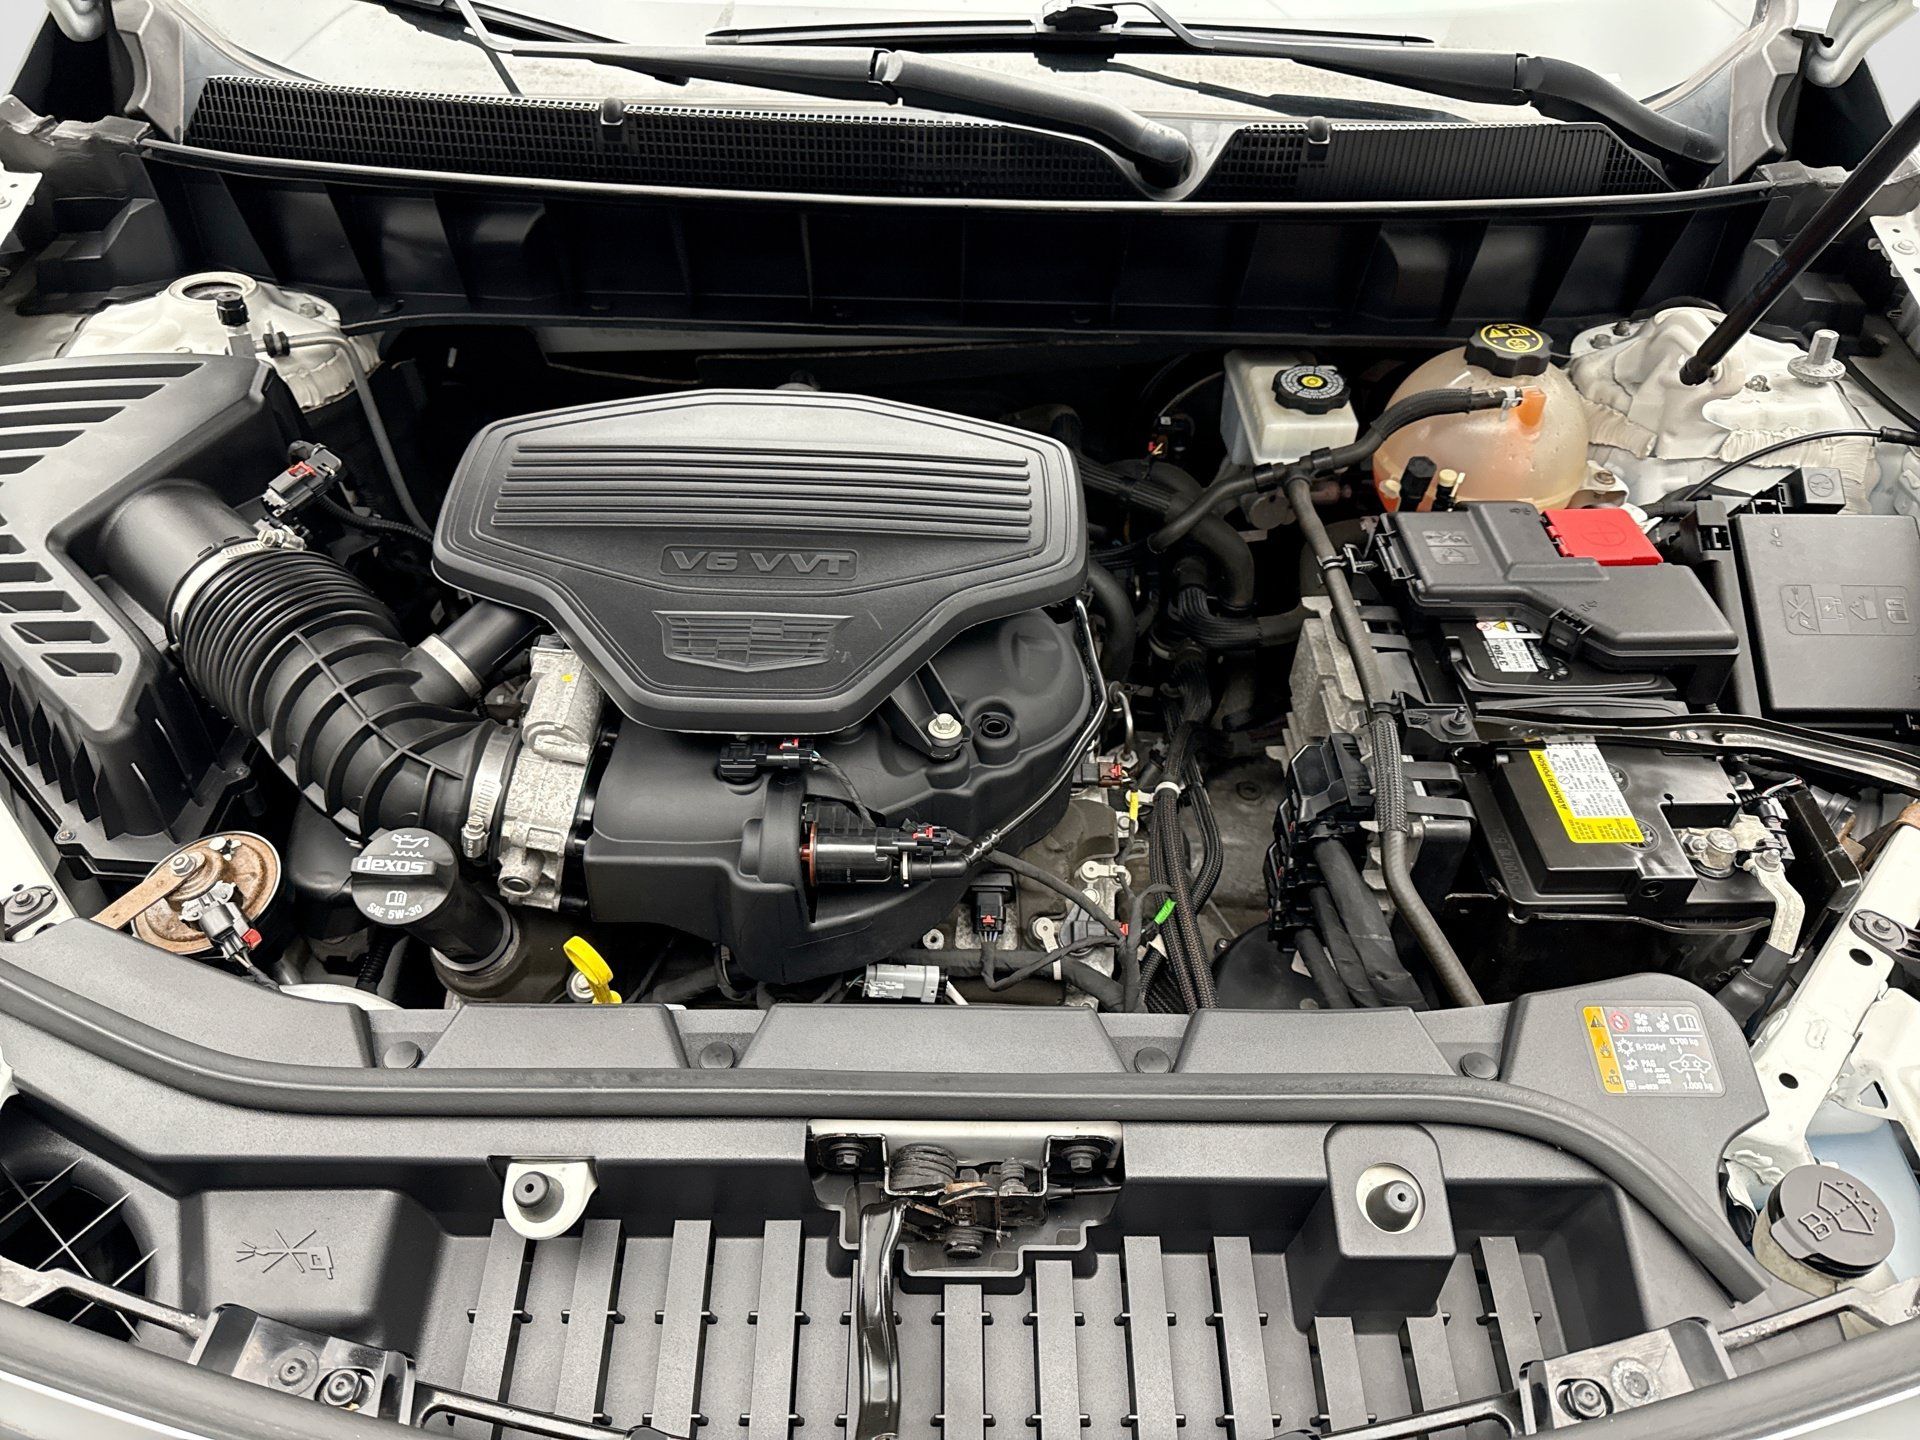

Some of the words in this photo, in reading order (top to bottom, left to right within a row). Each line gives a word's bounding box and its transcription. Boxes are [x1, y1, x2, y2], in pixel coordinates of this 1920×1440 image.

[670, 551, 738, 571] V6
[750, 552, 850, 575] VVT
[357, 856, 427, 873] dexos
[367, 902, 386, 918] SAE
[388, 904, 423, 919] 5W-30
